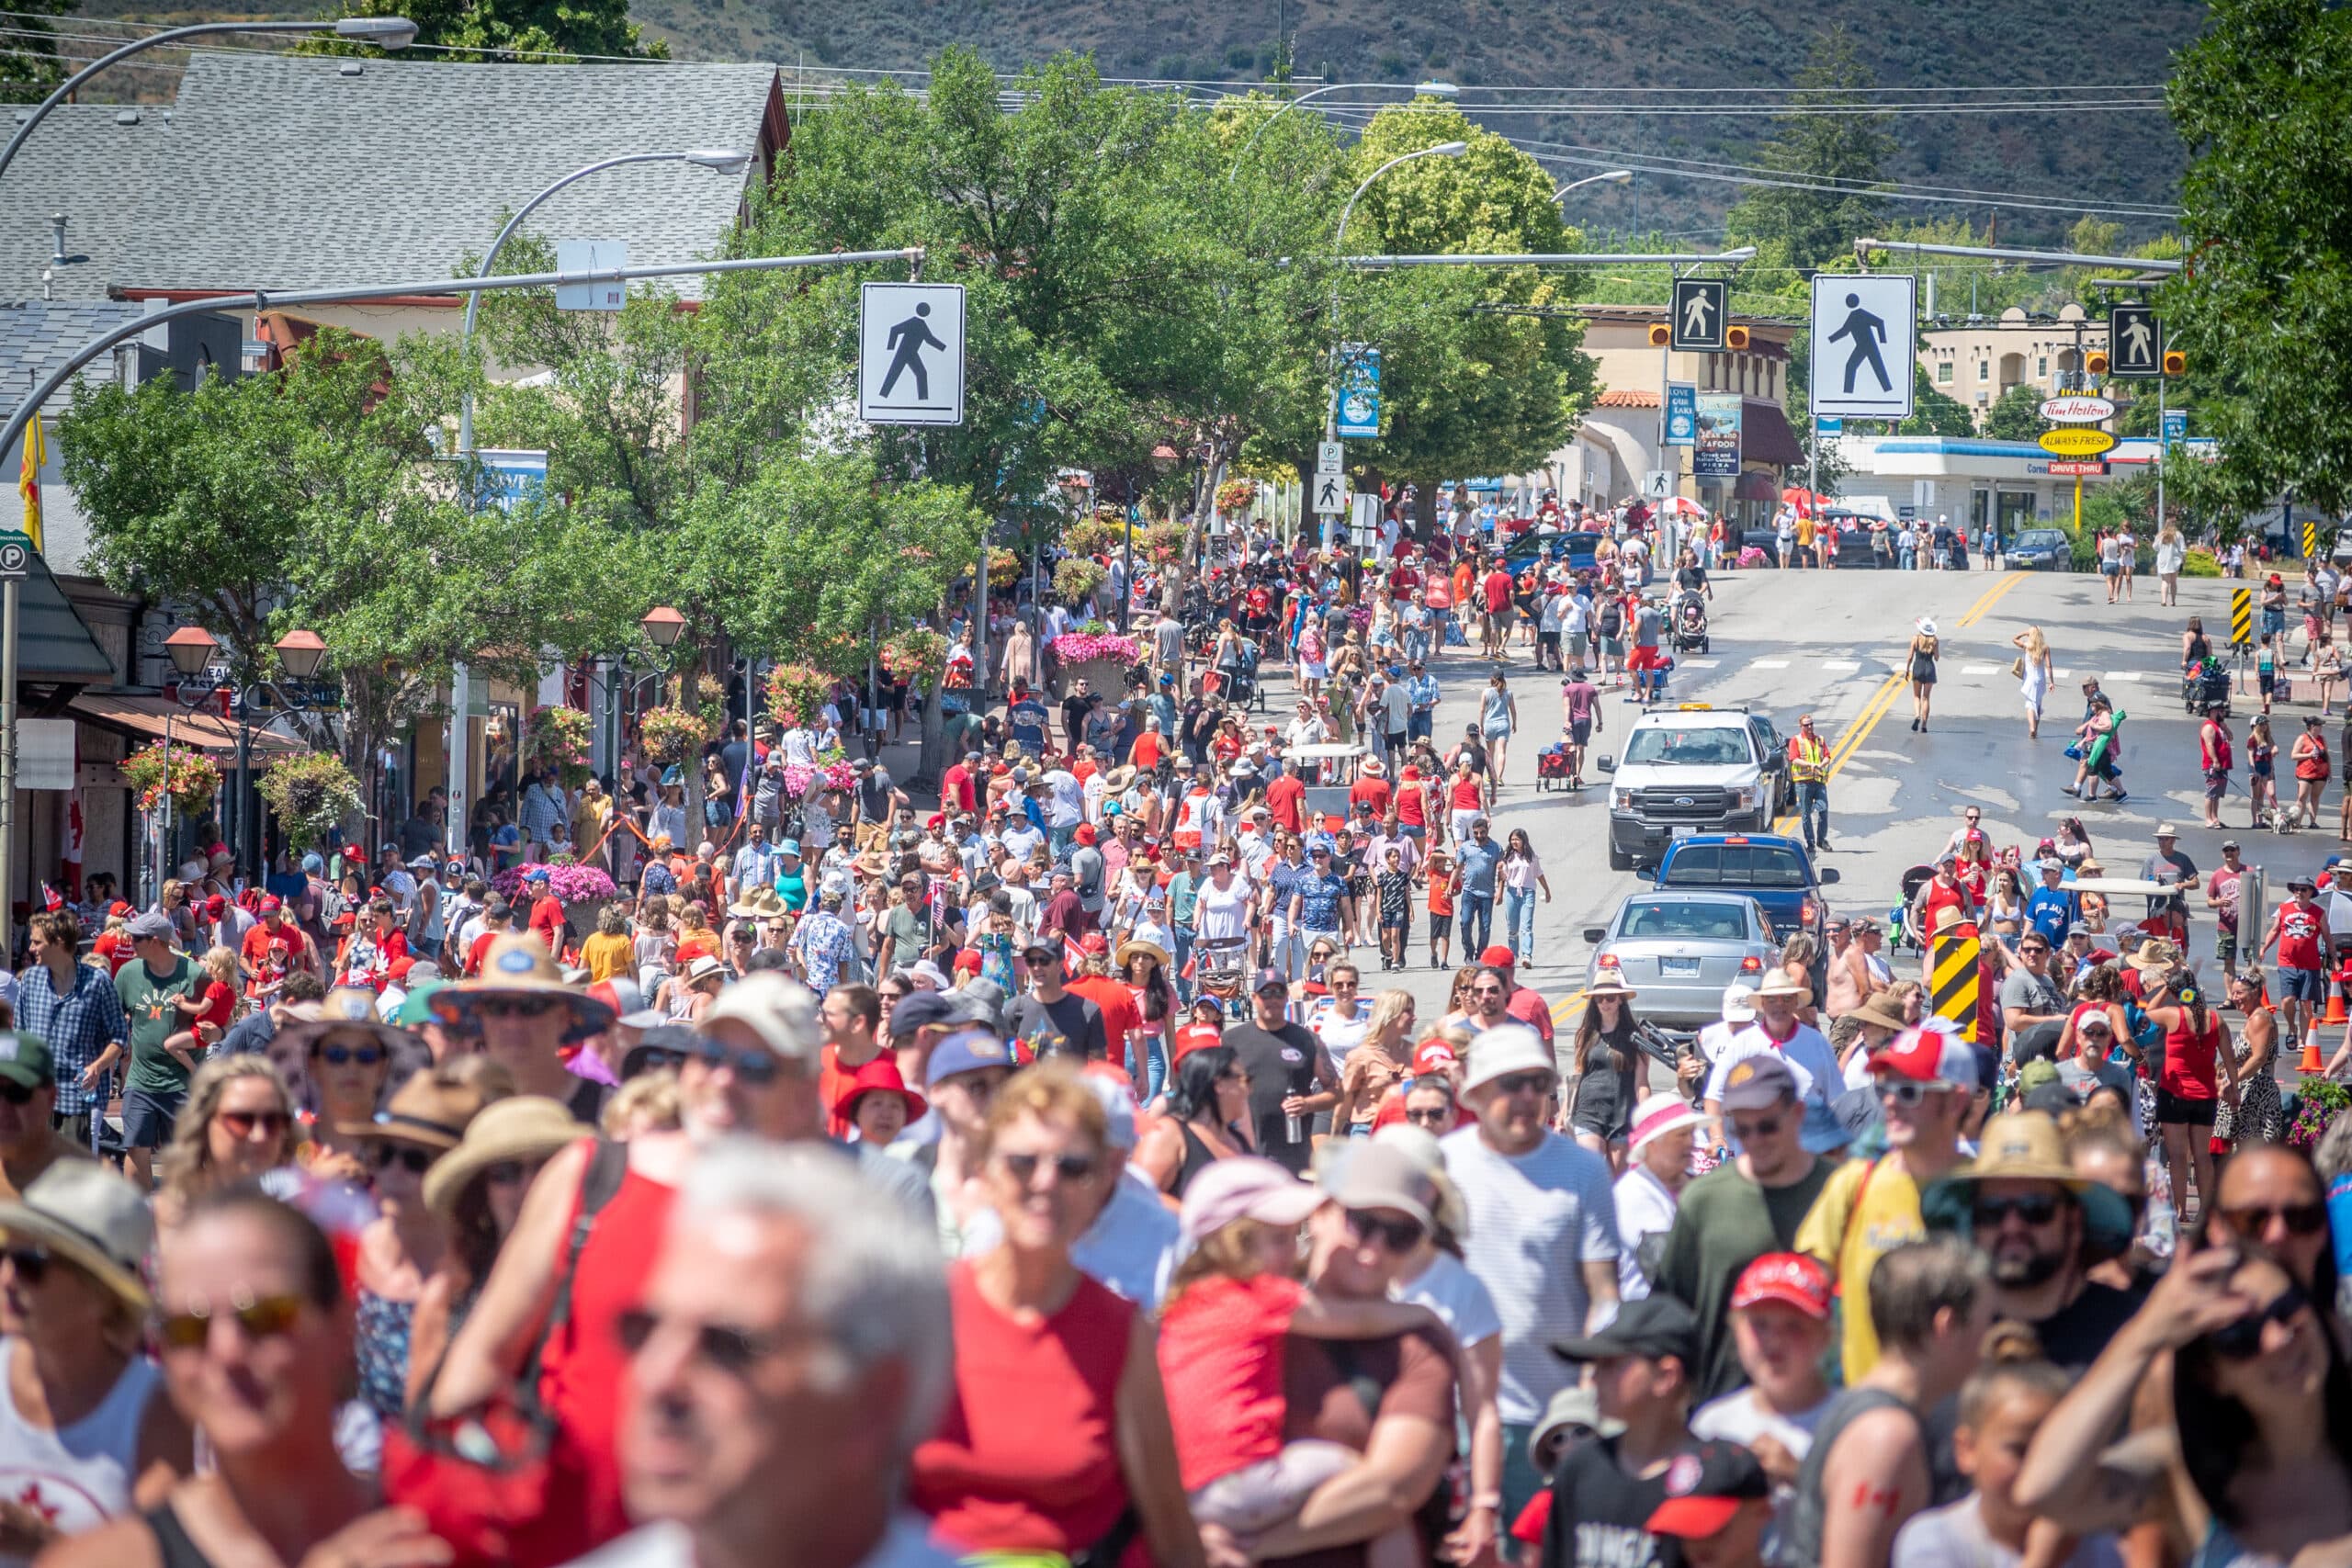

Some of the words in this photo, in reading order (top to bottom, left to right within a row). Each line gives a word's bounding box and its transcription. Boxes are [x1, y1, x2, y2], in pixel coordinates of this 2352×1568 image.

[2045, 402, 2066, 415] Tim
[2067, 400, 2109, 416] Hortons
[2043, 435, 2077, 446] ALWAYS
[2079, 435, 2109, 446] FRESH
[1327, 447, 1335, 456] P
[2027, 463, 2047, 474] Corne
[2051, 464, 2076, 473] DRIVE
[2078, 464, 2101, 473] THRU
[6, 548, 20, 566] P
